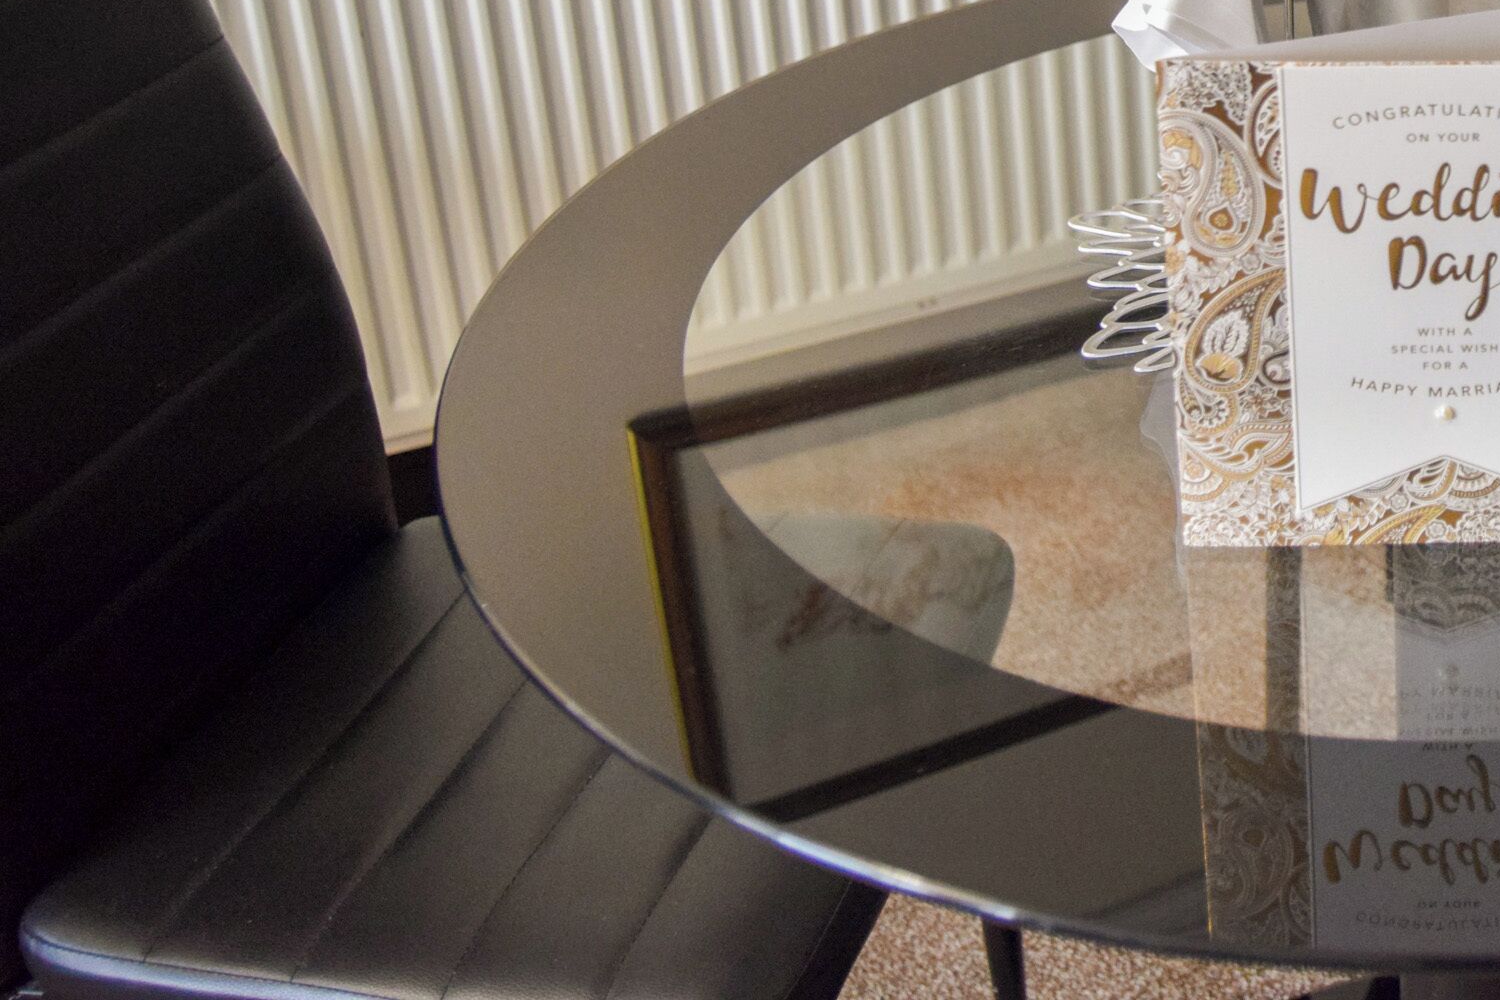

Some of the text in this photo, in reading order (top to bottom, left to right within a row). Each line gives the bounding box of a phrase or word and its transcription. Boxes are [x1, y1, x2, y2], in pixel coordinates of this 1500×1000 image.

[1406, 132, 1481, 143] ON YOUR
[1417, 327, 1473, 337] WITH A
[1391, 344, 1499, 354] SPECIAL WISH
[1423, 361, 1468, 370] FOR A
[1351, 376, 1419, 397] HAPPY
